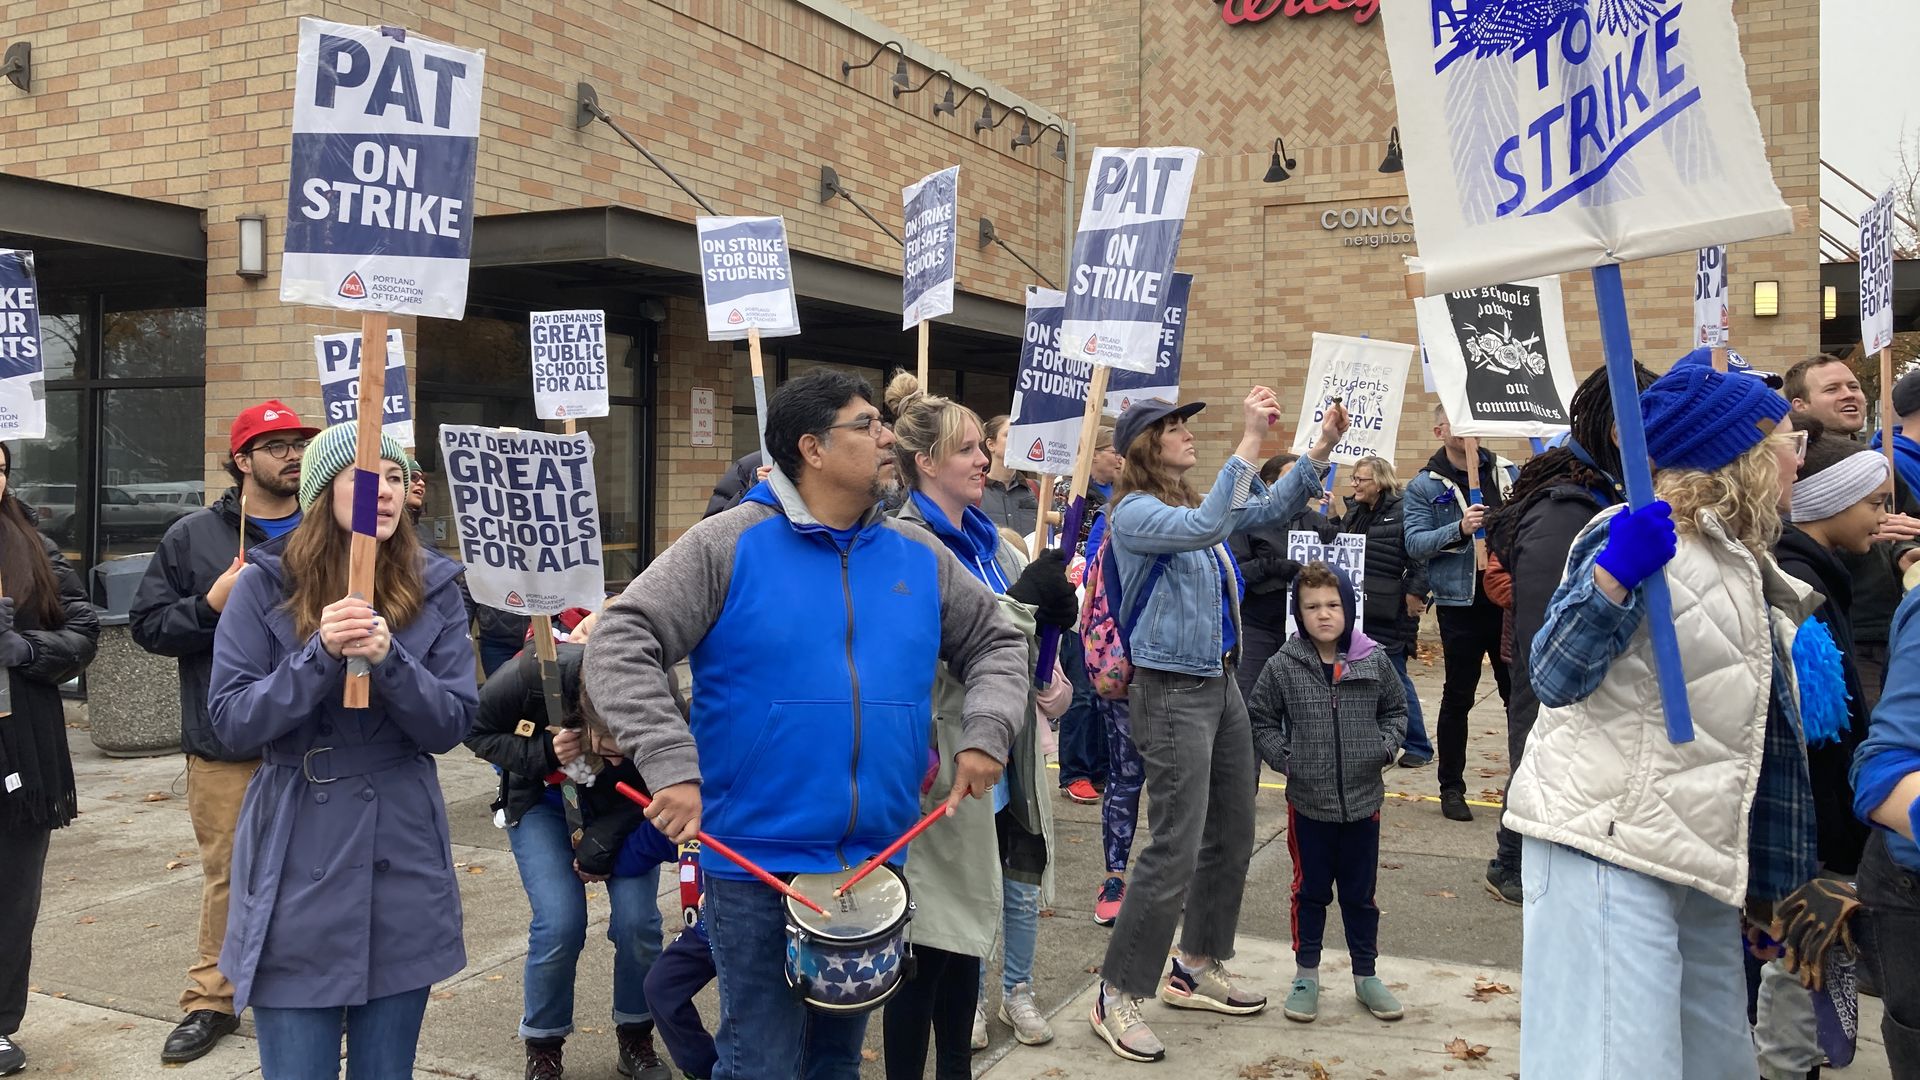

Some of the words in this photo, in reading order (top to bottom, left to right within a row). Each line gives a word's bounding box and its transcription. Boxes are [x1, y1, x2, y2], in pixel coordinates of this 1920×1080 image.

[1512, 6, 1592, 91] TO
[314, 33, 467, 130] PAT
[1493, 2, 1686, 218] STRIKE
[352, 141, 418, 188] ON
[1092, 156, 1184, 215] PAT
[301, 177, 463, 239] STRIKE
[905, 219, 918, 238] ON
[917, 203, 952, 230] STRIKE
[1860, 202, 1893, 254] GREAT
[703, 239, 726, 253] ON
[728, 237, 783, 252] STRIKE
[920, 226, 949, 250] SAFE
[1106, 233, 1139, 267] ON
[713, 252, 745, 268] FOR
[747, 251, 780, 266] OUR
[906, 247, 945, 280] SCHOOLS
[373, 274, 415, 286] PORTLAND
[707, 266, 786, 282] STUDENTS
[1073, 263, 1162, 306] STRIKE
[345, 283, 360, 291] PAT
[371, 284, 424, 295] ASSOCIATION
[371, 292, 382, 300] OF
[384, 293, 423, 304] TEACHERS
[1452, 287, 1478, 299] our
[1481, 285, 1531, 306] schools
[1477, 301, 1514, 320] power
[1861, 291, 1882, 321] FOR
[532, 315, 551, 325] PAT
[553, 313, 603, 323] DEMANDS
[533, 323, 603, 344] GREAT
[1026, 321, 1051, 346] ON
[534, 343, 605, 363] PUBLIC
[1032, 346, 1064, 372] FOR
[1065, 357, 1092, 379] OUR
[535, 361, 605, 377] SCHOOLS
[535, 377, 571, 393] FOR
[574, 375, 606, 391] ALL
[1021, 368, 1091, 402] STUDENTS
[1323, 374, 1389, 393] students
[1505, 382, 1530, 395] our
[1476, 400, 1562, 419] communities
[444, 431, 481, 449] PAT
[485, 435, 586, 457] DEMANDS
[449, 449, 588, 491] GREAT
[453, 484, 594, 523] PUBLIC
[459, 514, 597, 547] SCHOOLS
[1290, 534, 1310, 544] PAT
[463, 538, 530, 572] FOR
[537, 540, 600, 573] ALL
[1290, 545, 1363, 568] GREAT
